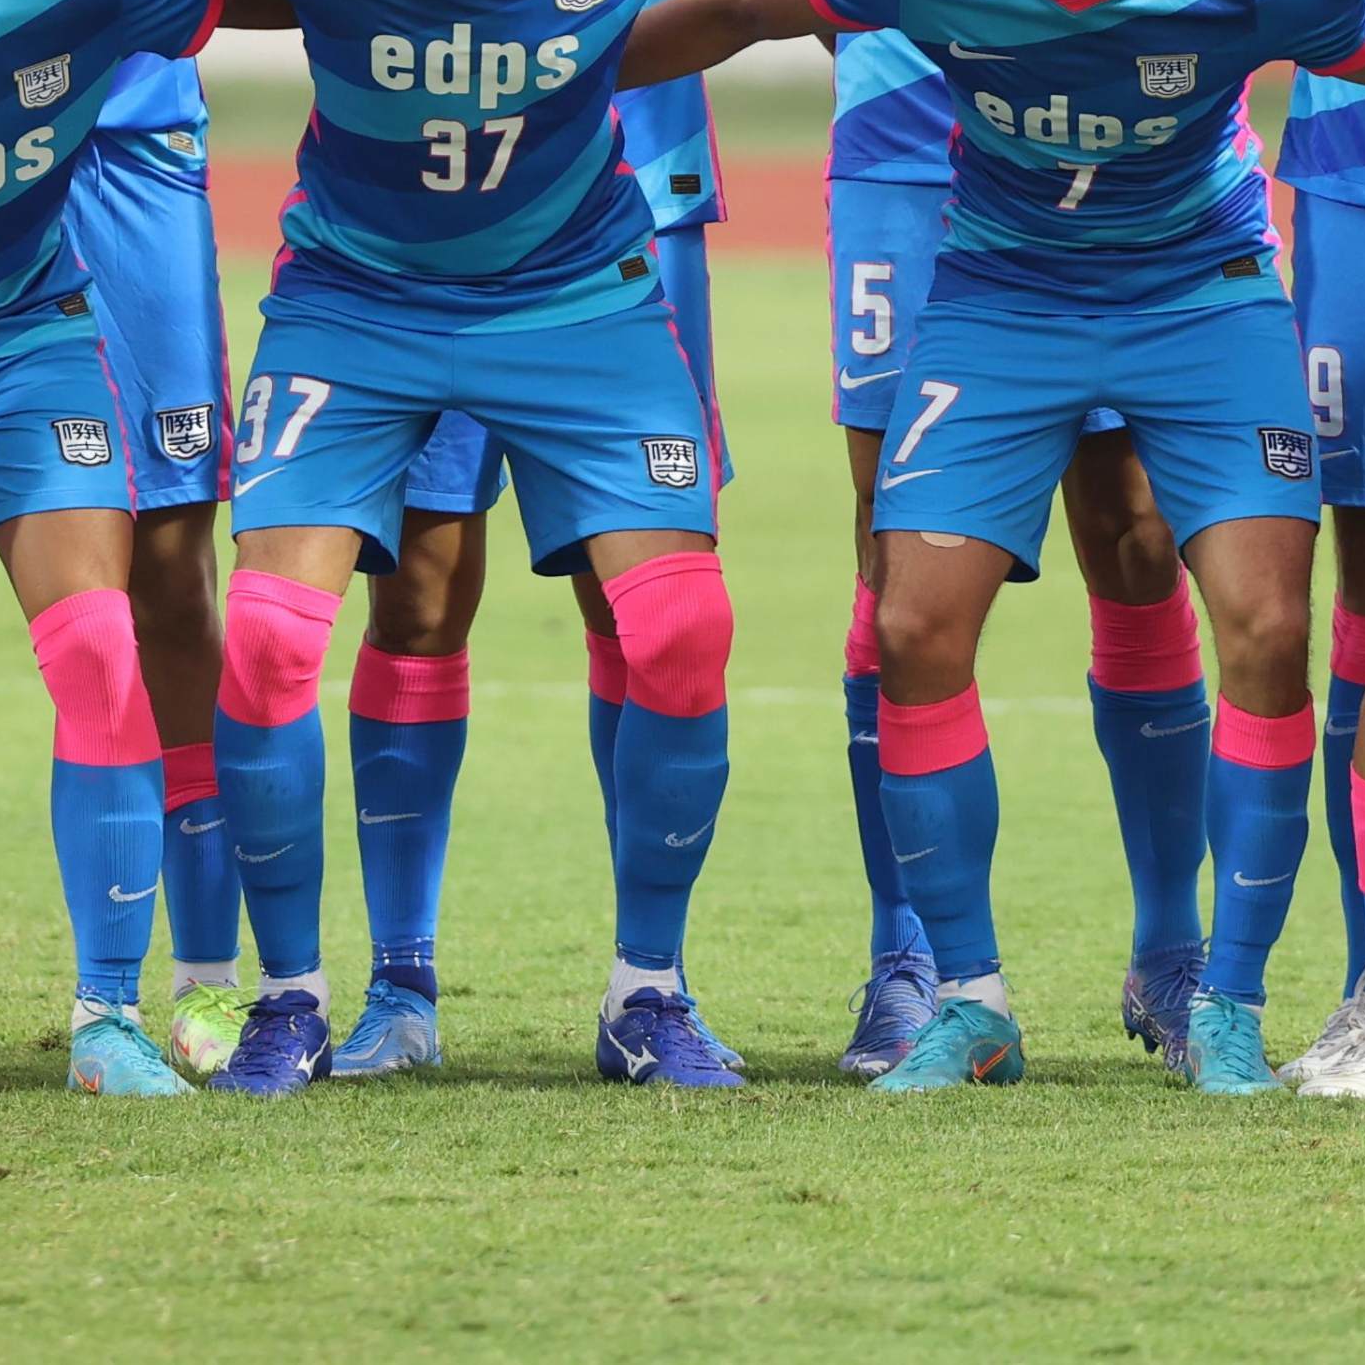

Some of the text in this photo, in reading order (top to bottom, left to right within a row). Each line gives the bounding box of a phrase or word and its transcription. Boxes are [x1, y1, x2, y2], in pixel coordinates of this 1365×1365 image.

[371, 23, 579, 109] edps
[421, 115, 525, 192] 37
[974, 91, 1179, 151] edps
[1056, 160, 1098, 210] 7
[851, 263, 892, 355] 5
[236, 374, 331, 464] 37
[892, 380, 960, 464] 7
[1308, 346, 1344, 437] 9
